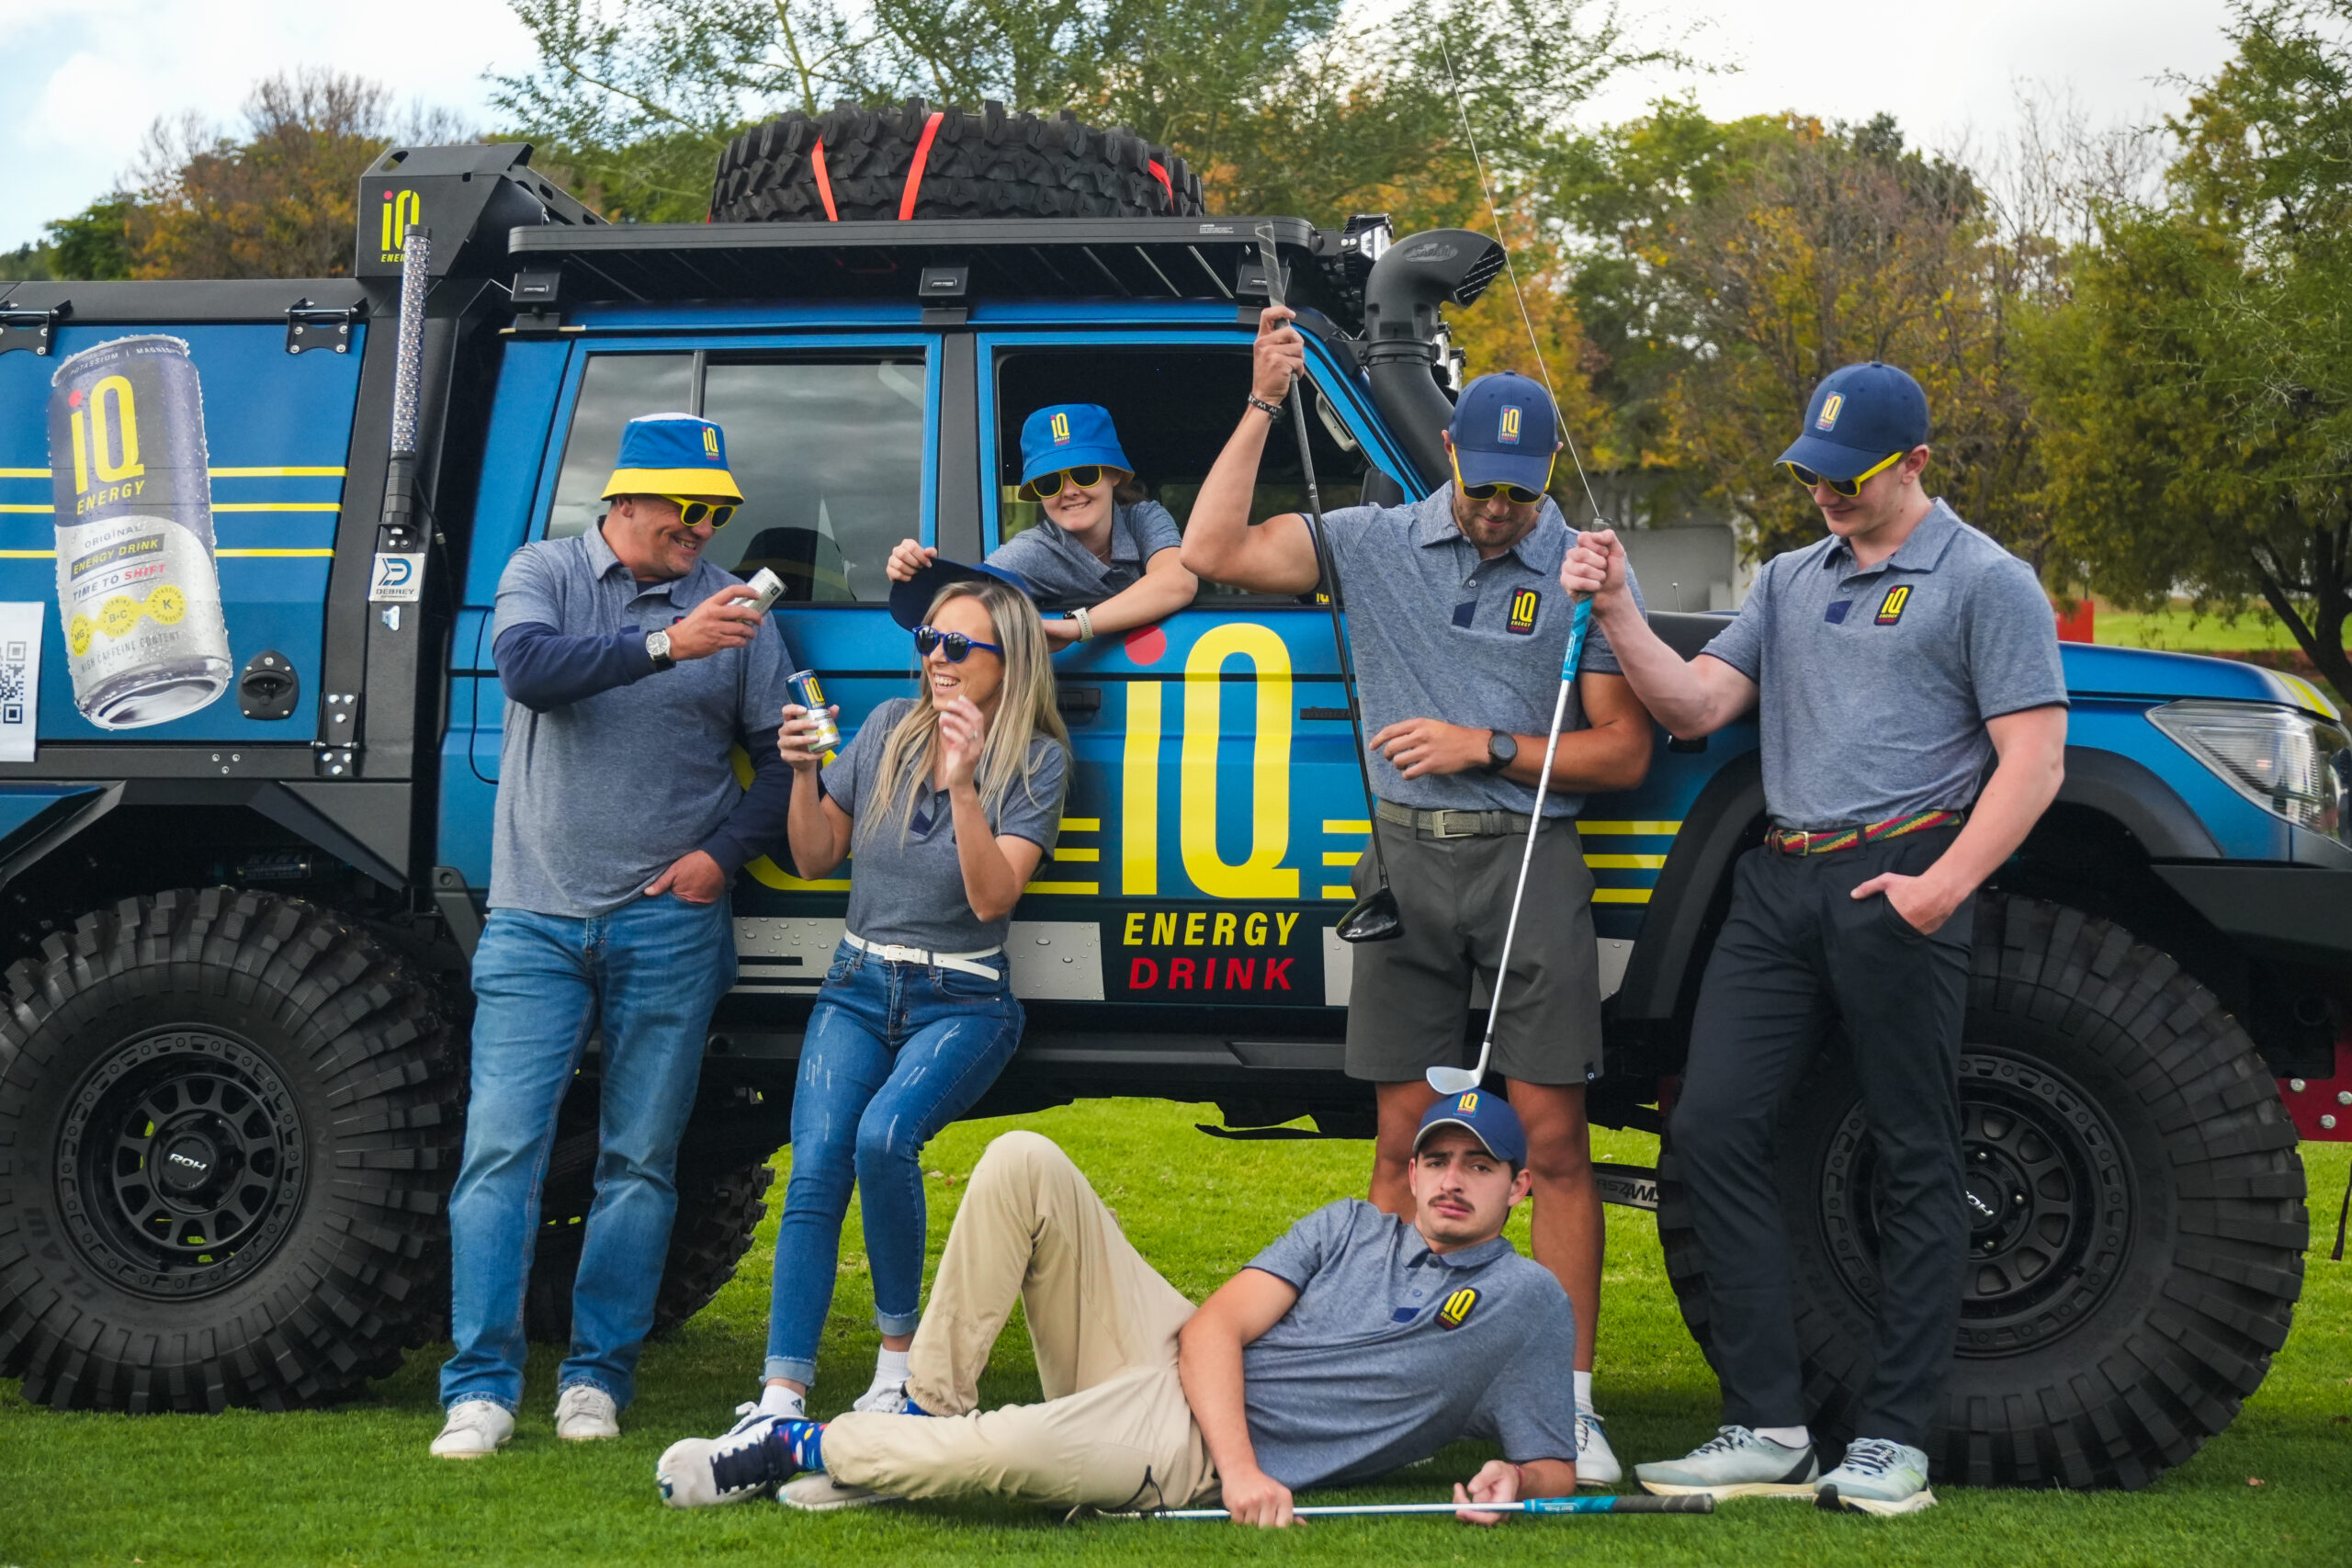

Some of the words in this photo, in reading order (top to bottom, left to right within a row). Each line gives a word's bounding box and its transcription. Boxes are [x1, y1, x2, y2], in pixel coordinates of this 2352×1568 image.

[1050, 412, 1070, 438] iQ
[1502, 408, 1519, 434] iQ
[69, 375, 145, 495] iQ
[702, 426, 718, 452] iQ
[76, 479, 145, 515] ENERGY
[85, 525, 142, 548] ORIGINAL
[74, 549, 115, 575] ENERGY
[119, 538, 159, 556] DRINK
[74, 581, 97, 602] TIME
[103, 575, 119, 587] TO
[125, 564, 165, 581] SHIFT
[163, 598, 173, 610] K
[1512, 591, 1536, 623] iQ
[1881, 587, 1908, 614] iQ
[74, 628, 85, 641] MG
[81, 657, 96, 673] HIGH
[97, 640, 136, 663] CAFFEINE
[140, 630, 180, 648] CONTENT
[803, 677, 825, 704] iQ
[1122, 623, 1300, 898] iQ
[1122, 911, 1300, 946] ENERGY
[1128, 957, 1296, 990] DRINK
[1458, 1092, 1478, 1110] iQ
[169, 1153, 207, 1171] ROH
[1966, 1190, 1994, 1217] OH
[1443, 1288, 1476, 1322] iQ
